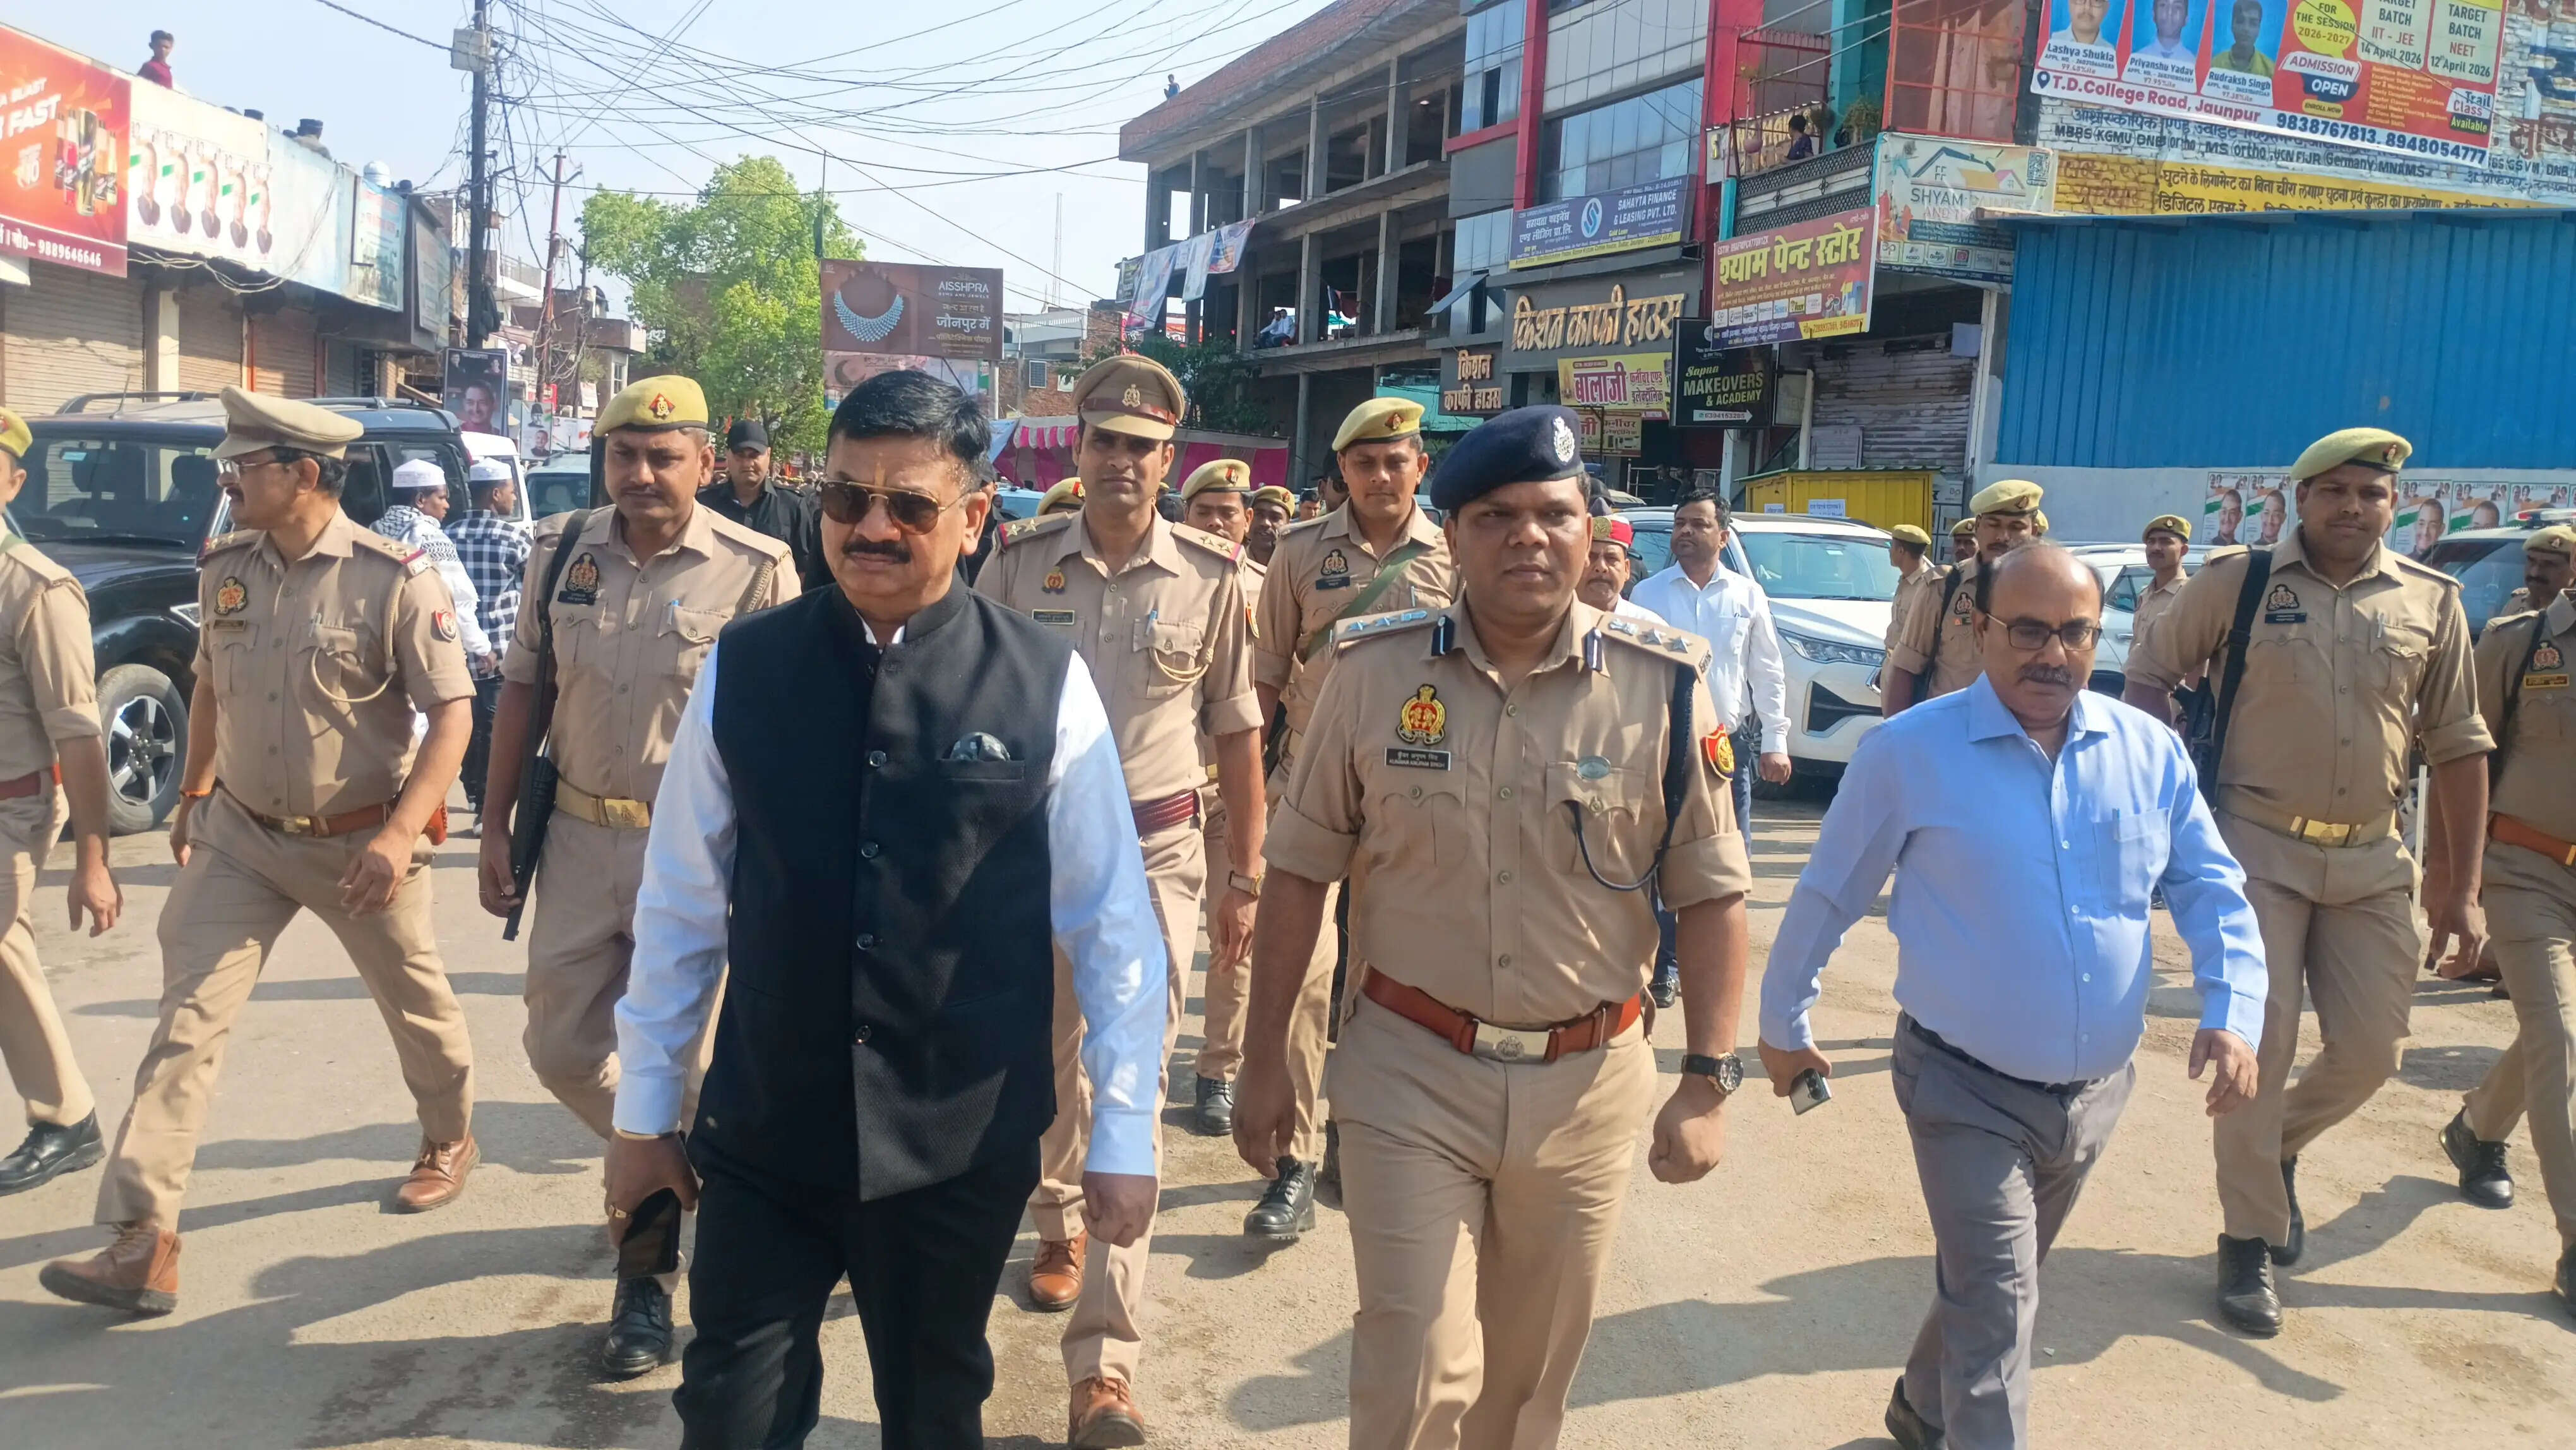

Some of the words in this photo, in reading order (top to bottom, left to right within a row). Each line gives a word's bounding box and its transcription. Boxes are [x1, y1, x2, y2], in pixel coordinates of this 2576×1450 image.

[2319, 2, 2337, 14] FOR
[2379, 8, 2412, 26] BATCH
[2448, 4, 2487, 23] TARGET
[2296, 11, 2313, 23] THE
[2316, 15, 2356, 31] SESSION
[2298, 27, 2351, 45] 2026-2027
[2371, 26, 2385, 40] IIT
[2396, 30, 2415, 46] JEE
[2448, 22, 2481, 40] BATCH
[2048, 43, 2080, 57] Lashya
[2082, 49, 2114, 62] Shukla
[2373, 44, 2397, 59] April
[2399, 50, 2422, 64] 2026
[2450, 42, 2475, 57] NEET
[2130, 57, 2168, 71] Priyanshu
[2171, 64, 2193, 76] Yadav
[2290, 56, 2354, 76] ADMISSION
[2442, 59, 2466, 73] April
[2469, 63, 2491, 77] 2026
[2209, 71, 2246, 86] Rudraksh
[2248, 78, 2270, 90] Singh
[2311, 80, 2349, 97] OPEN
[2147, 90, 2190, 112] Road,
[2195, 99, 2261, 123] Jaunpur
[2305, 102, 2326, 113] ENROLL
[2453, 100, 2483, 116] Class
[2464, 90, 2491, 107] Trail
[8, 93, 62, 138] FAST
[2450, 115, 2488, 133] Available
[2054, 125, 2092, 140] MBBS
[2385, 132, 2486, 164] 8948054777
[1618, 195, 1647, 210] SAHAYTA
[1648, 189, 1677, 205] FINANCE
[1911, 188, 1964, 206] SHYAM
[2239, 177, 2252, 190] का
[2255, 175, 2274, 193] बिना
[2276, 177, 2297, 197] चीरा
[2390, 195, 2402, 208] का
[2158, 191, 2205, 213] डिजिटल
[1613, 215, 1618, 225] &
[1619, 210, 1646, 224] LEASING
[1647, 208, 1661, 220] PVT.
[1662, 205, 1677, 216] LTD.
[1719, 246, 1770, 285] श्याम
[1774, 235, 1814, 273] पेन्ट
[1816, 222, 1864, 267] स्टोर
[938, 280, 989, 293] AISSHPRA
[977, 315, 991, 330] में
[1512, 295, 1568, 352] किशन
[1566, 284, 1626, 347] काफी
[1624, 293, 1686, 347] हाउस
[1457, 350, 1492, 381] किशन
[1685, 365, 1719, 378] Sapna
[1574, 361, 1627, 405] बालाजी
[1683, 372, 1763, 397] MAKEOVERS
[1444, 383, 1473, 410] काफी
[1474, 387, 1503, 409] हाउस
[1706, 395, 1713, 407] &
[1716, 389, 1762, 405] ACADEMY
